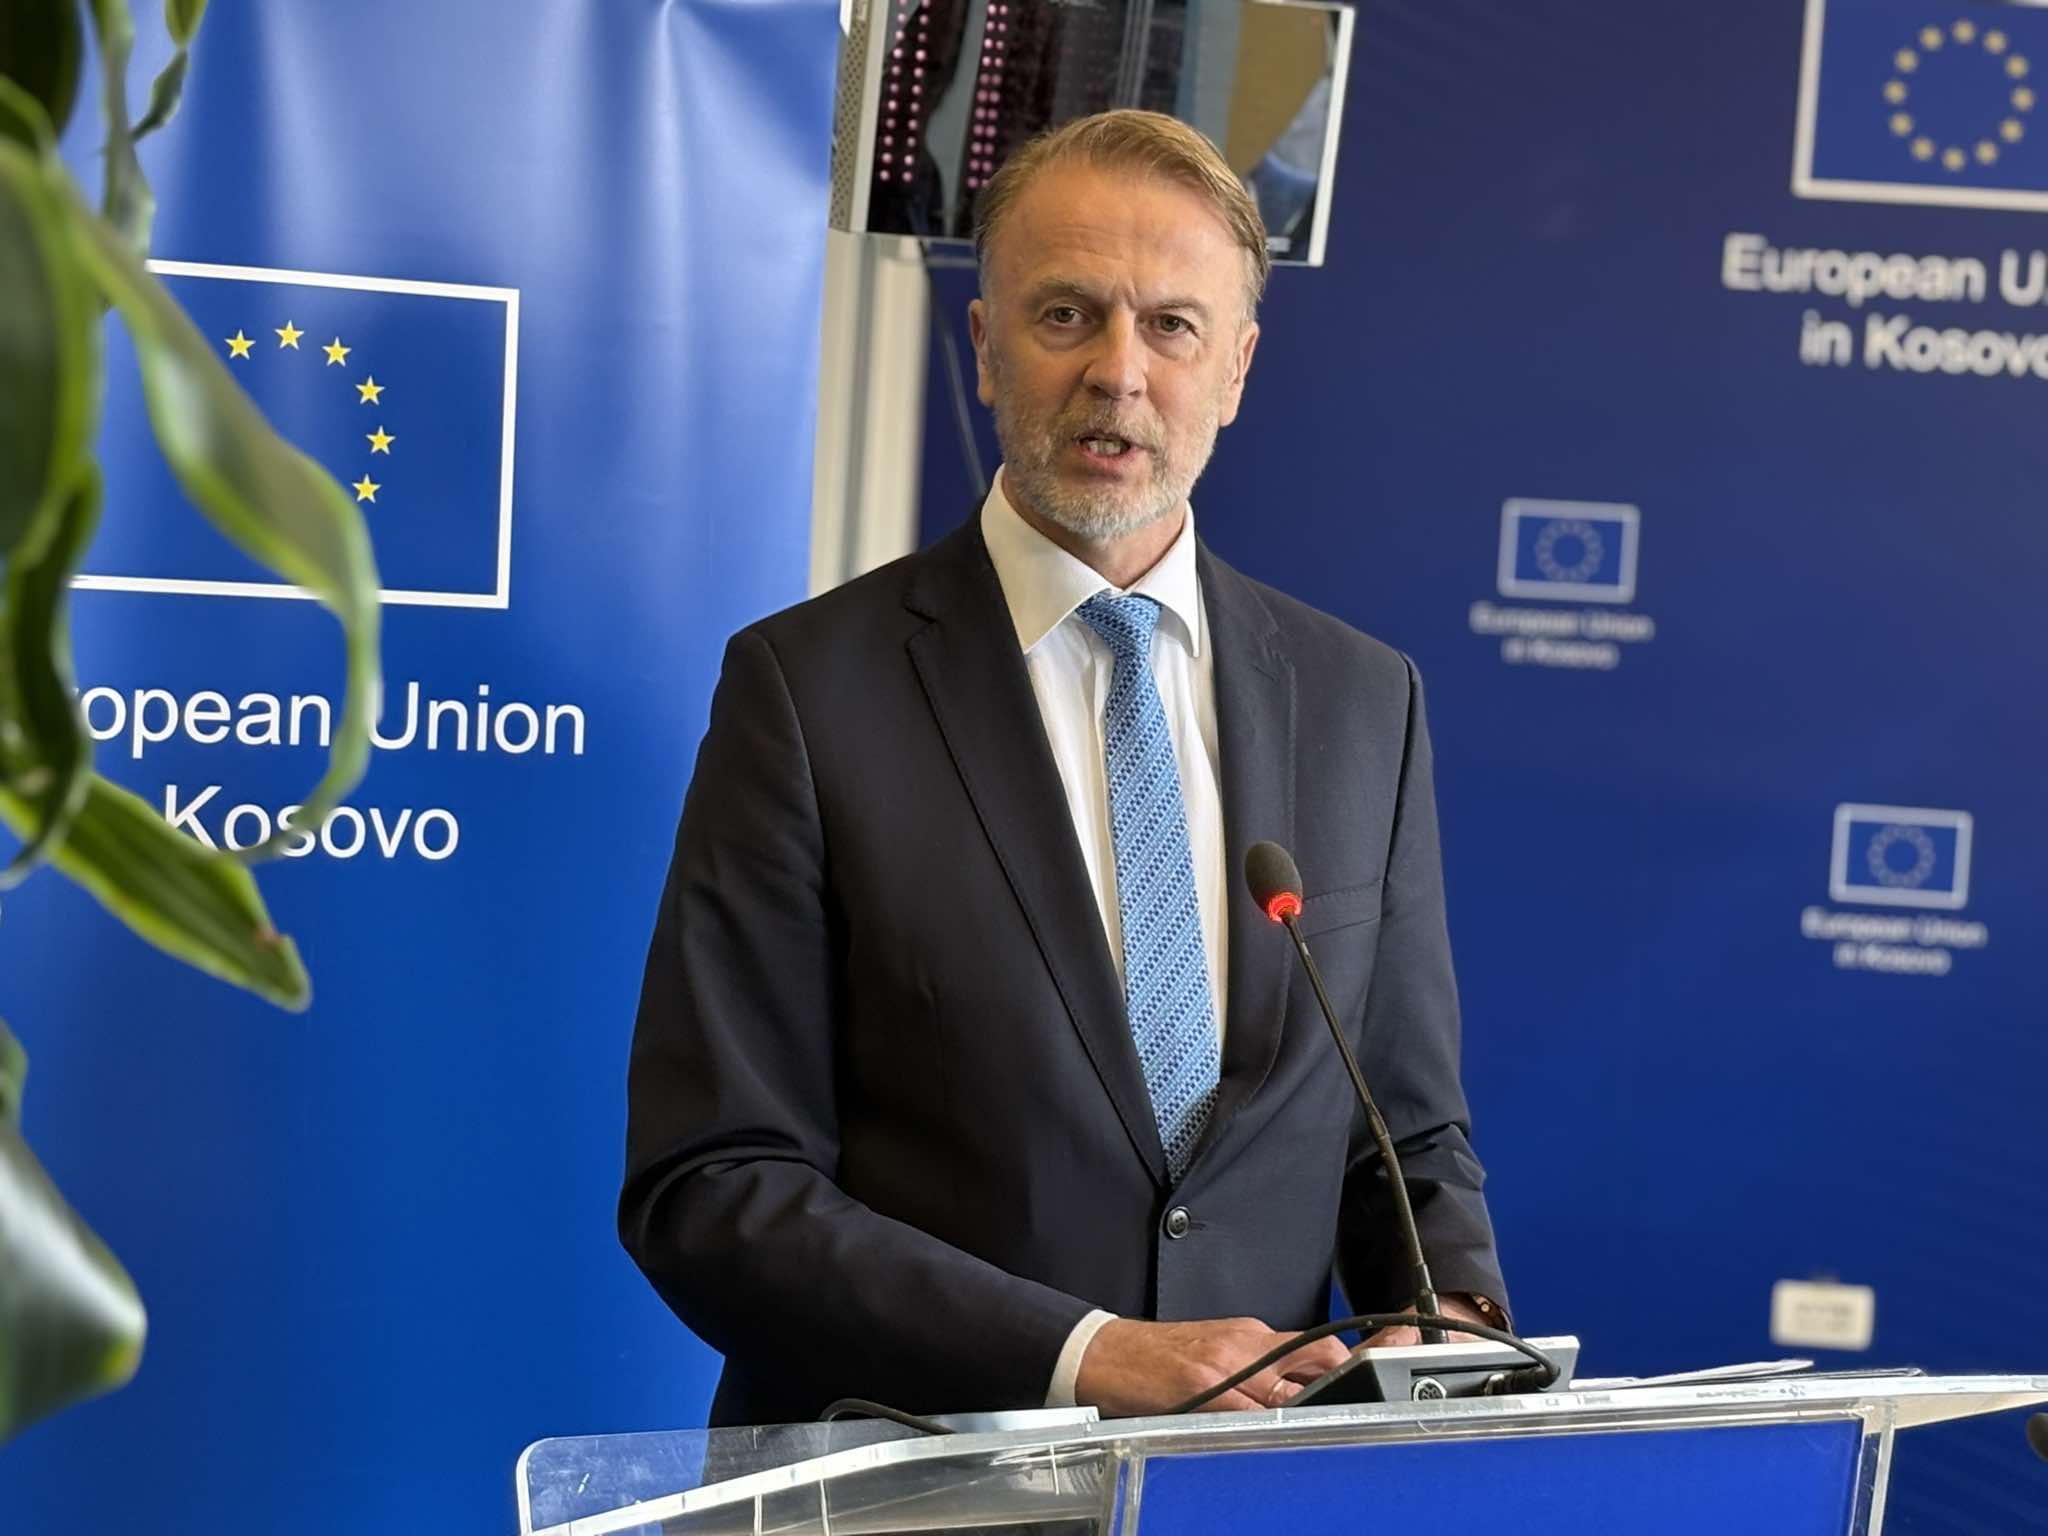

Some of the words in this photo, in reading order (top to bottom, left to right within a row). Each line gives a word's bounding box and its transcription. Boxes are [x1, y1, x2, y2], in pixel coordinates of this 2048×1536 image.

[1722, 233, 1986, 309] European
[2000, 249, 2048, 306] U
[1800, 309, 1852, 368] in
[74, 686, 331, 760] opean
[368, 681, 585, 755] Union
[164, 784, 460, 861] Kosovo
